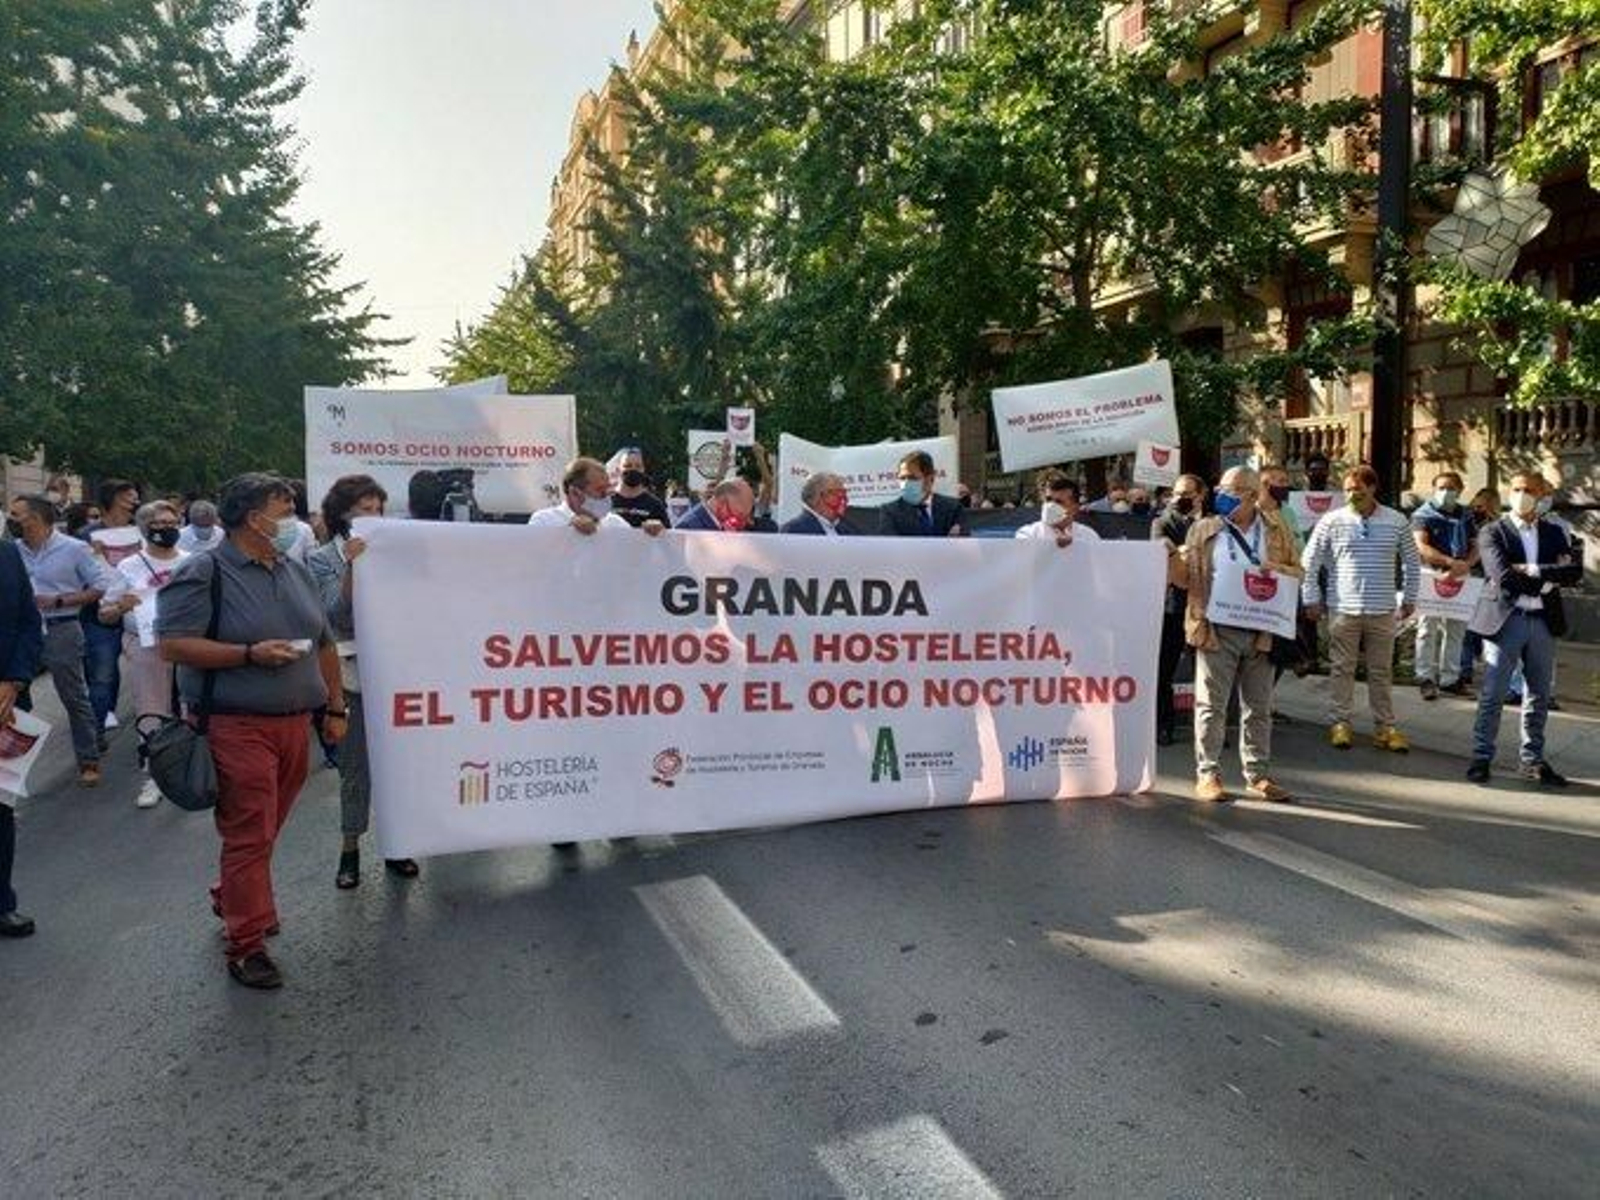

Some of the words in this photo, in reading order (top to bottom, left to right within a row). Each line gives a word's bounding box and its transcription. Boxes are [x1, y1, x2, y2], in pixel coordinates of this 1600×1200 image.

[1029, 409, 1072, 424] SOMOS
[1075, 407, 1091, 417] EL
[1094, 394, 1163, 414] PROBLEMA
[330, 441, 398, 457] SOMOS
[405, 442, 450, 458] OCIO
[457, 444, 556, 459] NOCTURNO
[660, 575, 929, 617] GRANADA
[484, 633, 730, 668] SALVEMOS
[746, 633, 798, 664] LA
[812, 625, 1072, 666] HOSTELERÍA,
[392, 691, 454, 727] EL
[470, 683, 685, 722] TURISMO
[701, 683, 728, 713] Y
[744, 681, 793, 711] EL
[808, 679, 909, 710] OCIO
[924, 675, 1137, 708] NOCTURNO
[496, 783, 518, 801] DE
[525, 778, 590, 799] ESPAÑA
